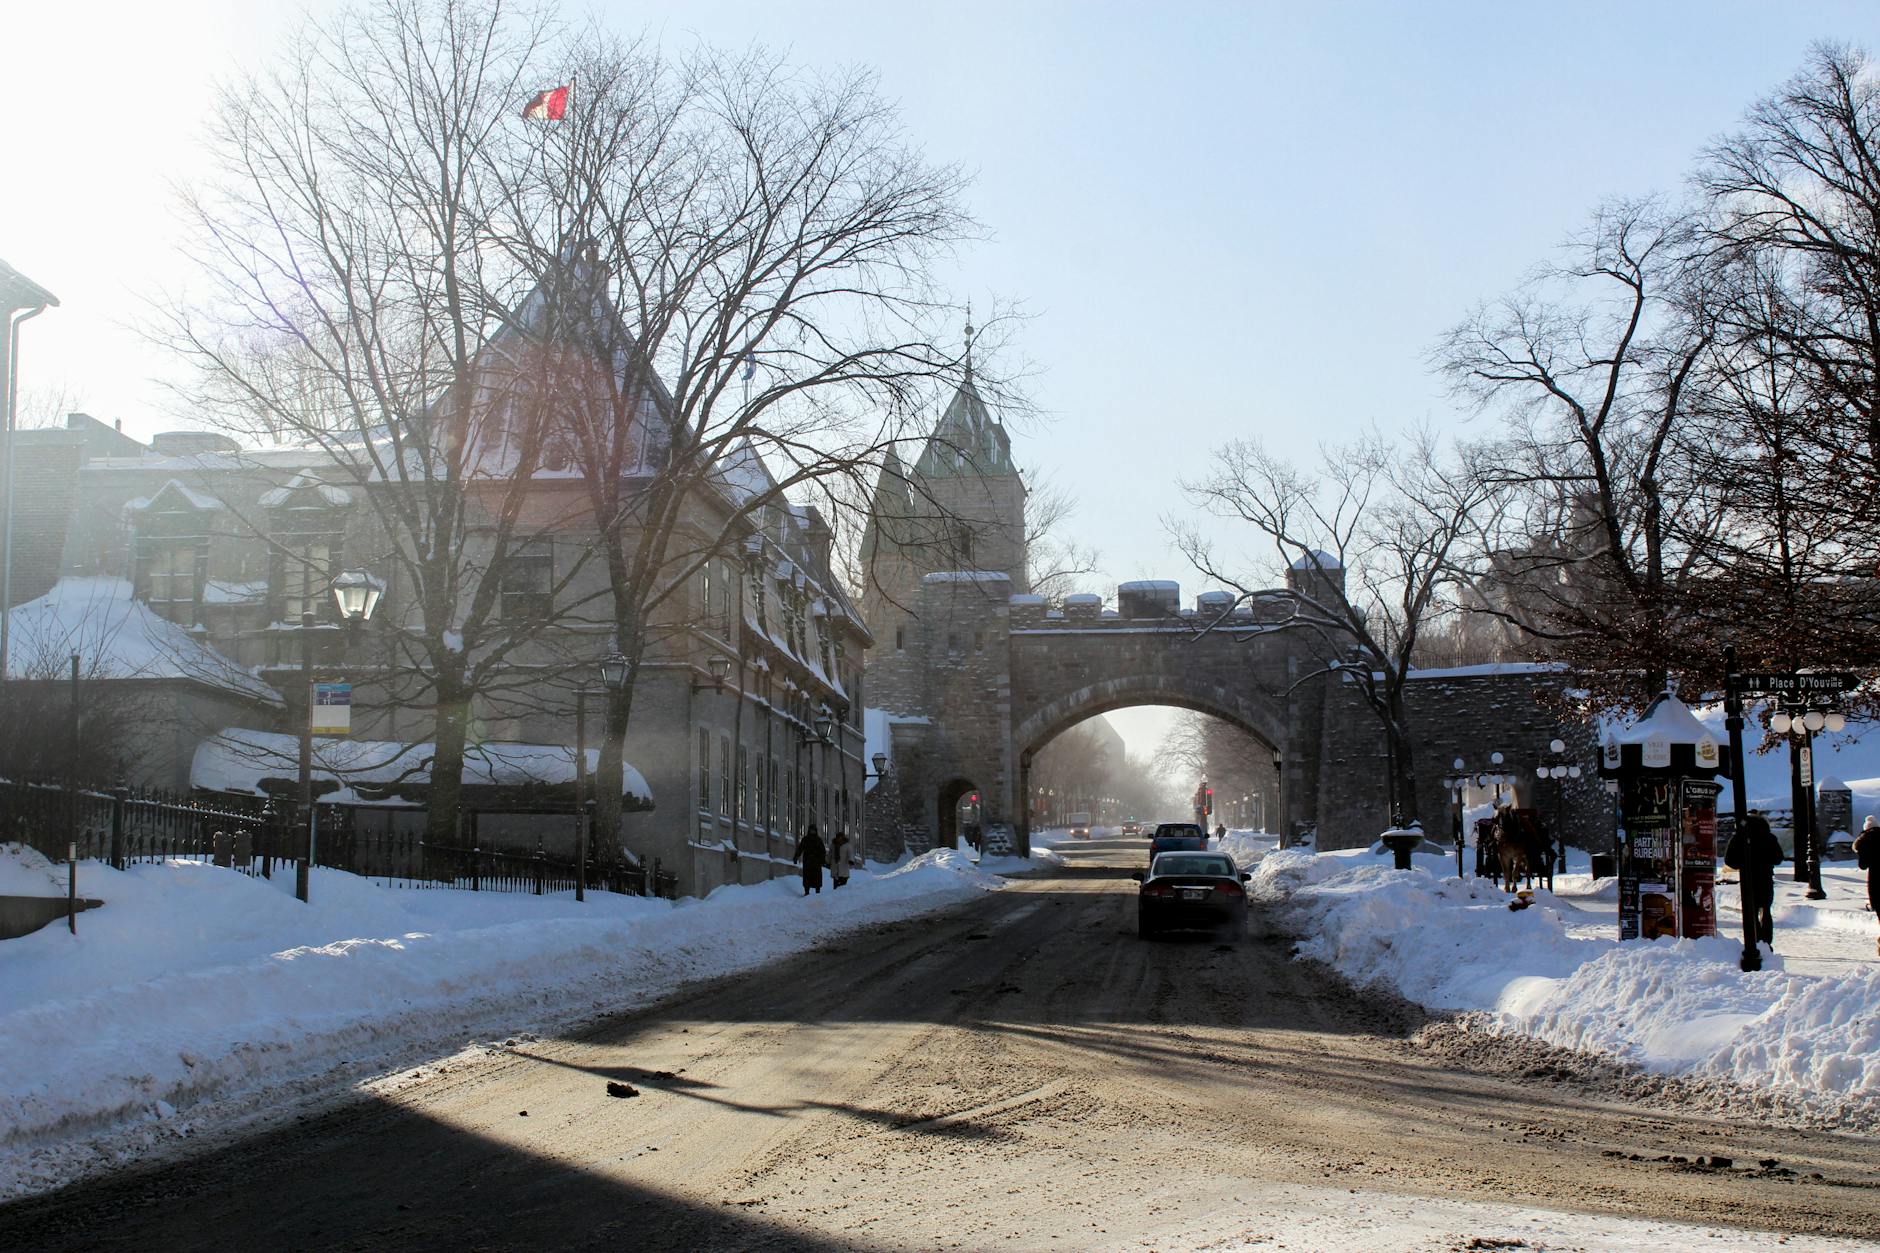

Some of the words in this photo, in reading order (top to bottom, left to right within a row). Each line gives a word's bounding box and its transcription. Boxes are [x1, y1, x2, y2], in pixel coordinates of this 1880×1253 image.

[1769, 676, 1794, 689] Place
[1799, 676, 1843, 689] D'Youville
[1634, 837, 1656, 848] PARTY
[1634, 847, 1663, 859] BUREAU
